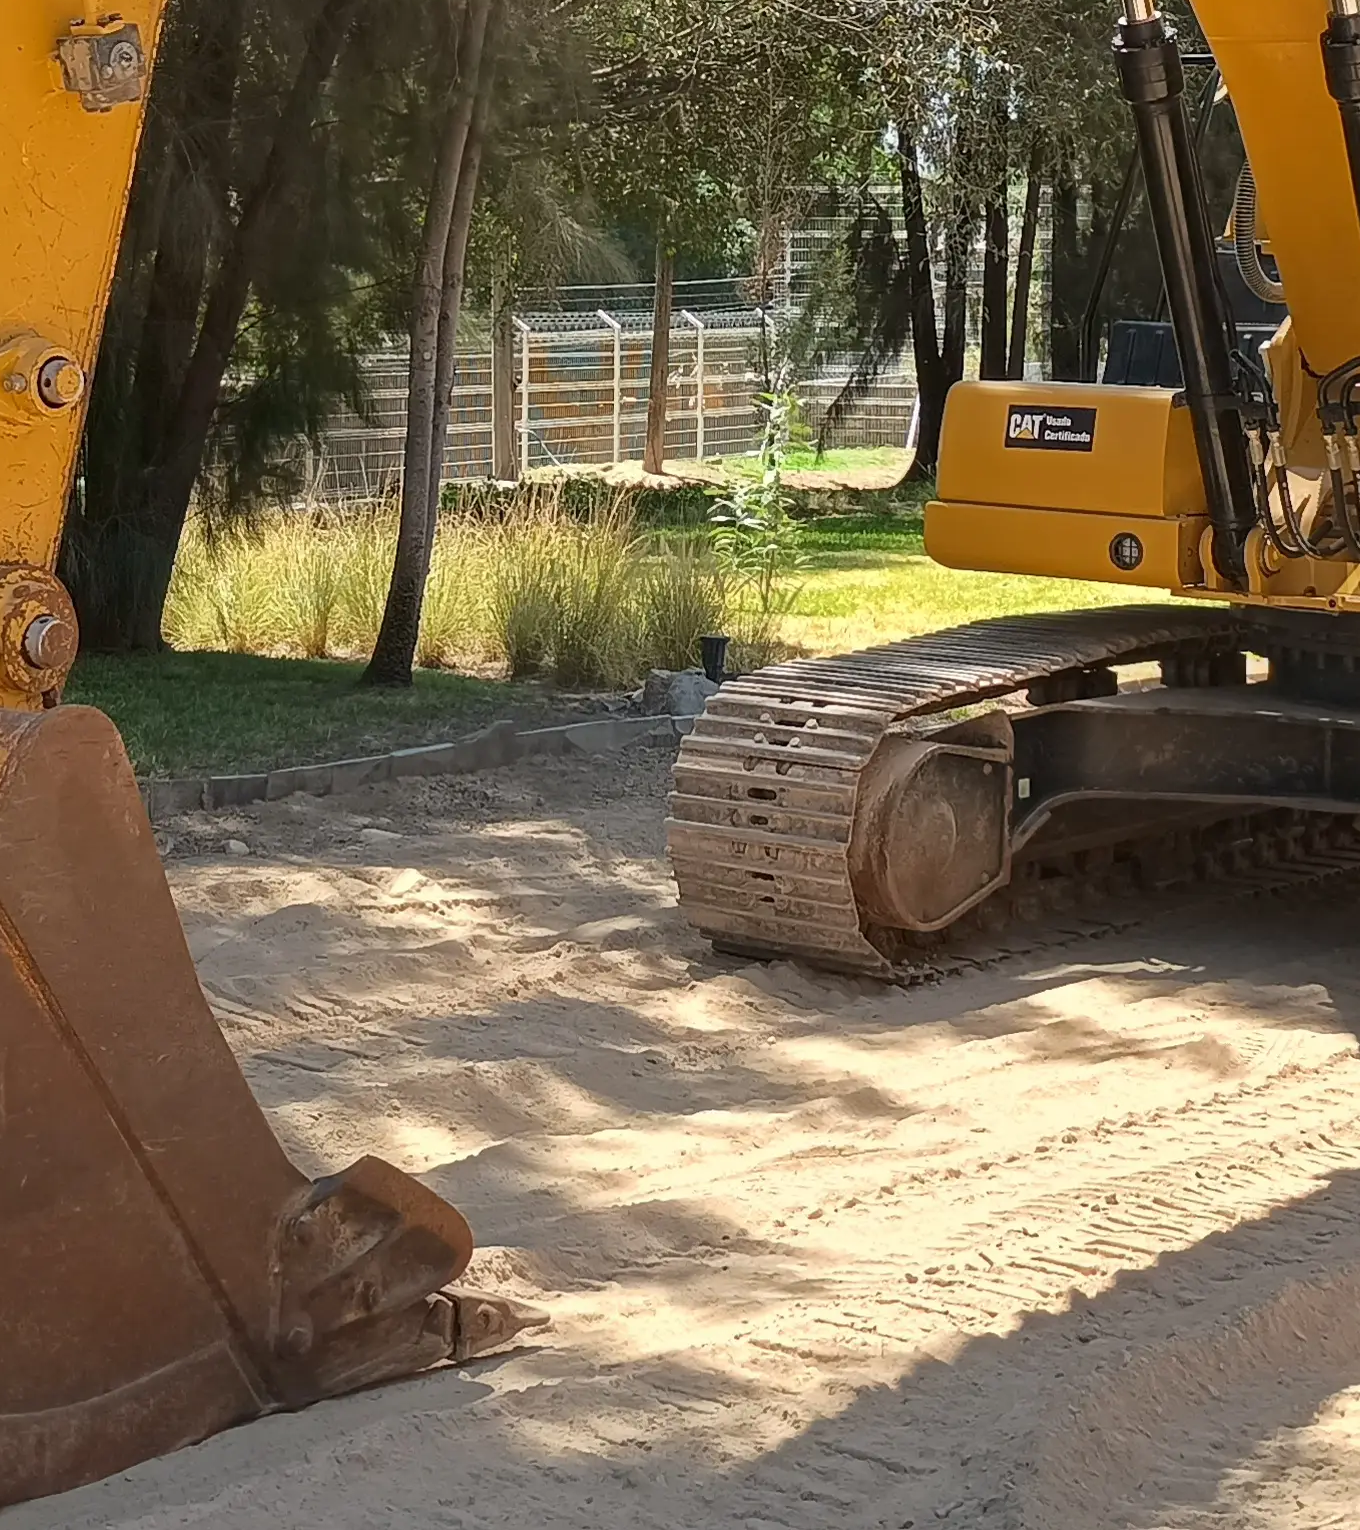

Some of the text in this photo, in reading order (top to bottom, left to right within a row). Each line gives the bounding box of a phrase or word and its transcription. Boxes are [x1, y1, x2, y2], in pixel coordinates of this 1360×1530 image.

[1009, 413, 1044, 440] CAT
[1046, 415, 1071, 427] Usado
[1044, 430, 1091, 443] Certificado
